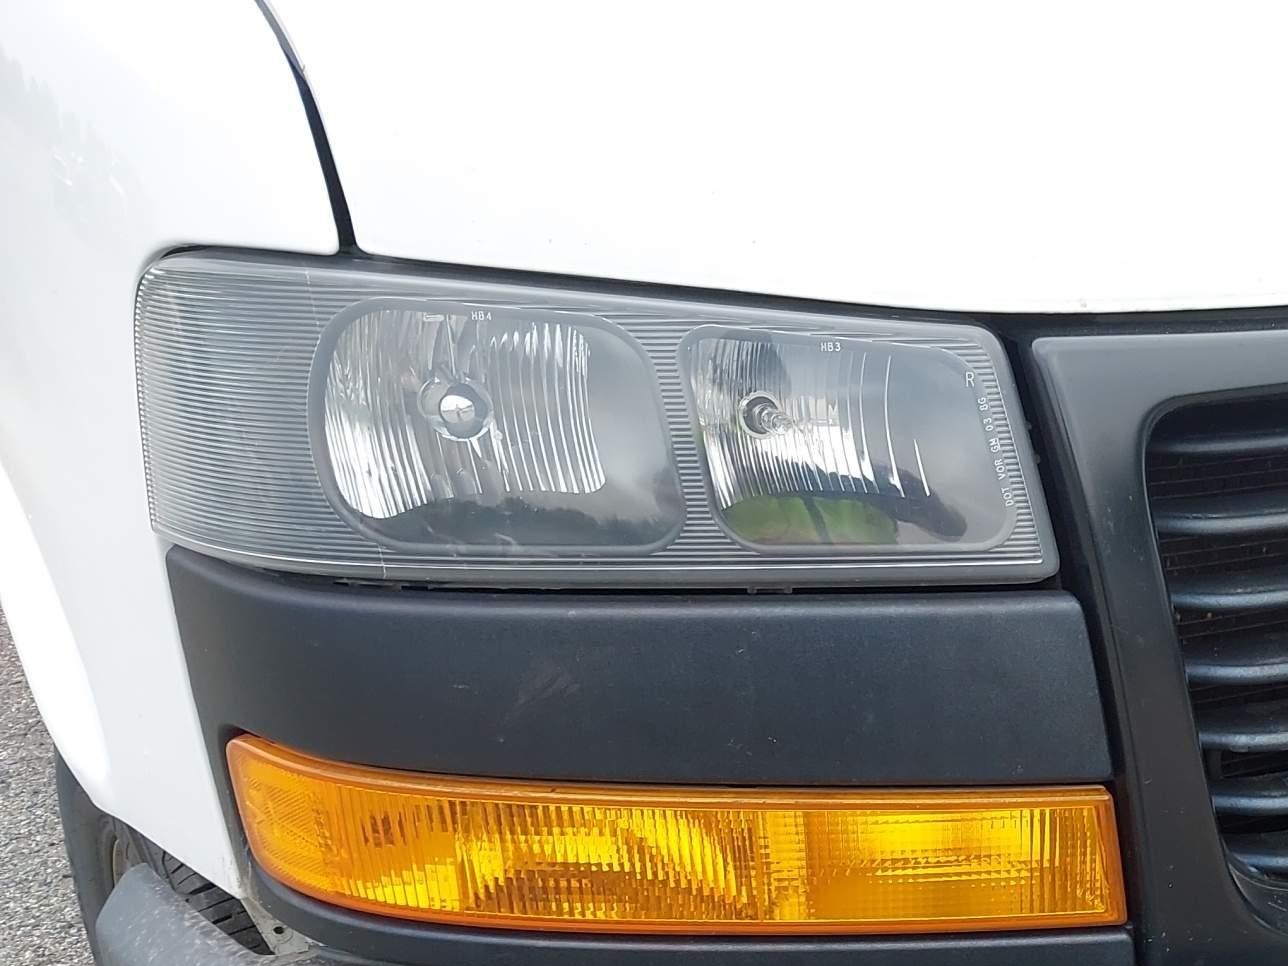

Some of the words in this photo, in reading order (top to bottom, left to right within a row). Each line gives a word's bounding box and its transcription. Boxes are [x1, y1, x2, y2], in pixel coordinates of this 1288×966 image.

[471, 310, 492, 321] HB4
[820, 341, 841, 352] HB3
[965, 371, 975, 388] R
[1001, 487, 1014, 507] DOT
